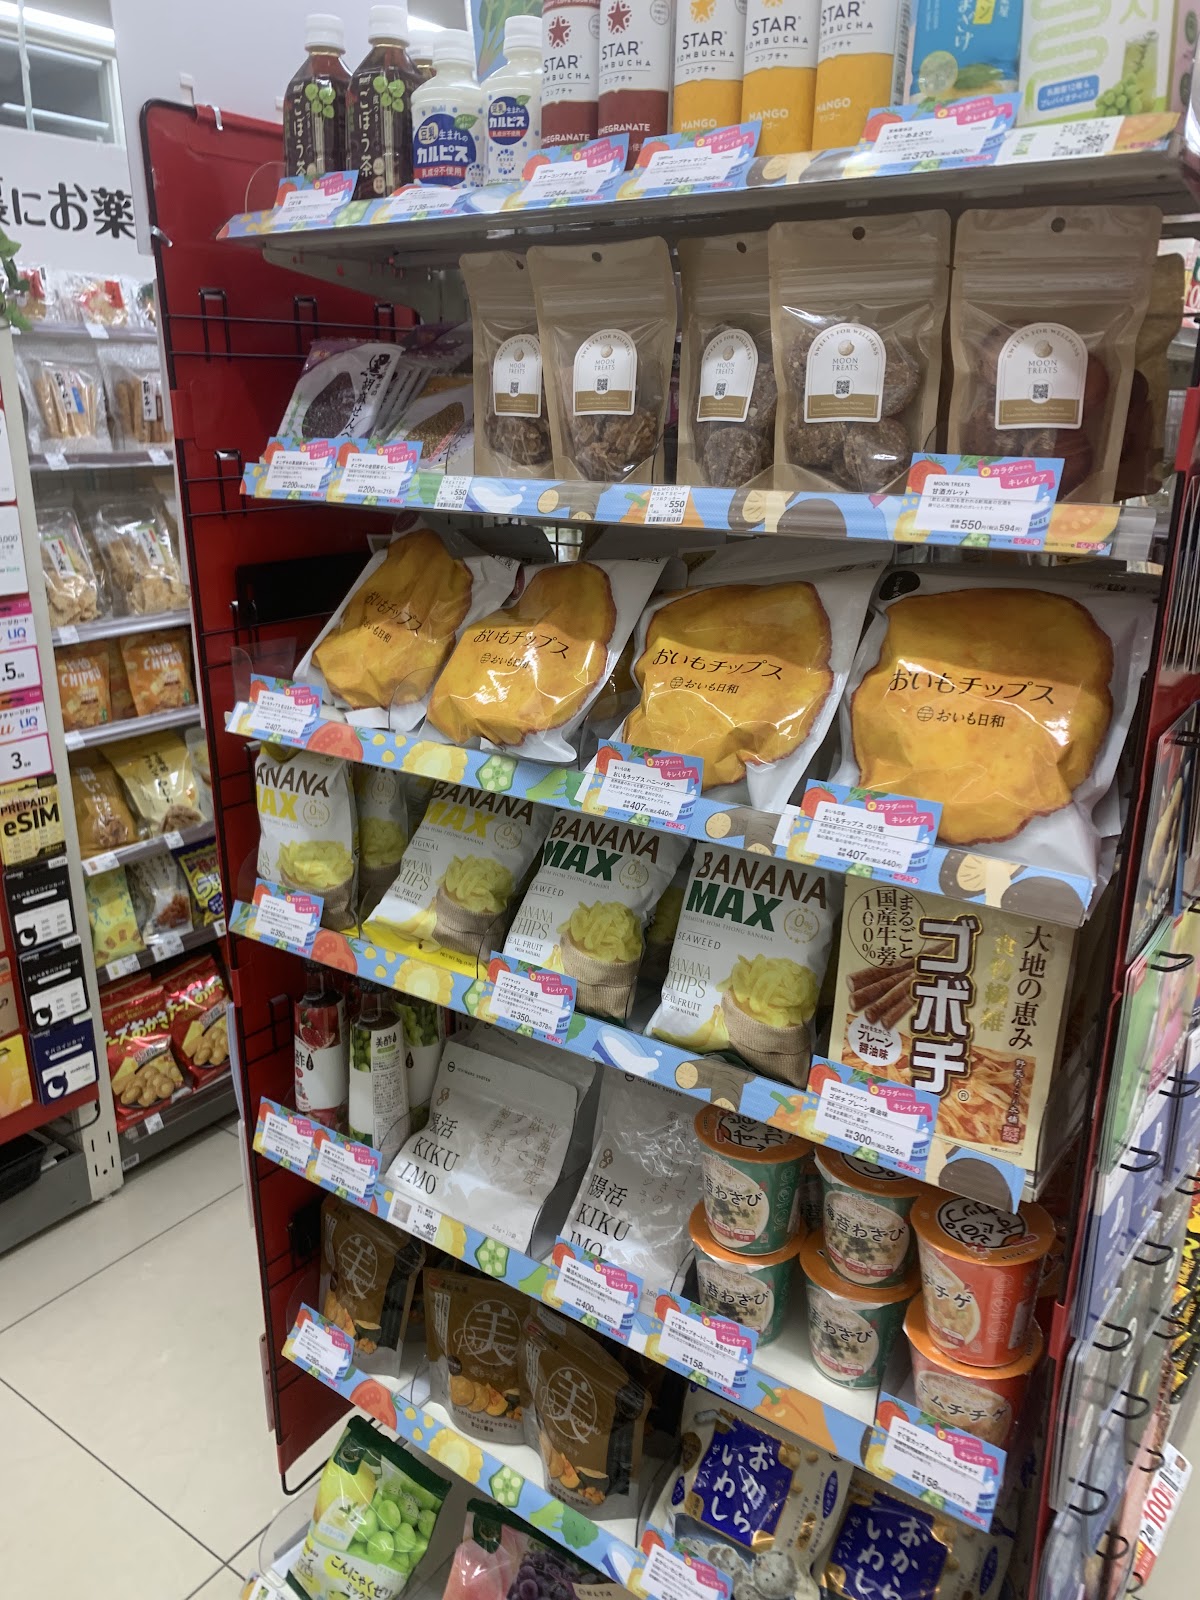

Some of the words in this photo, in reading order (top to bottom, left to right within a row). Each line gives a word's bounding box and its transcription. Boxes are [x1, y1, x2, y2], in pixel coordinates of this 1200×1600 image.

[751, 15, 797, 36] STAR
[602, 41, 639, 60] STAR
[683, 31, 723, 50] STAR
[543, 55, 578, 73] STAR
[489, 116, 526, 128] カルピス
[681, 118, 717, 131] MANGO
[359, 87, 373, 178] ごぼう茶
[417, 145, 468, 164] カルピス
[0, 177, 136, 240] にお薬
[595, 358, 615, 366] MOON
[715, 368, 735, 376] TREATS
[717, 361, 735, 369] MOON
[1026, 366, 1059, 374] TREATS
[1027, 359, 1058, 367] MOON
[1008, 474, 1047, 487] キレイケア
[473, 628, 569, 659] おいもチップス
[652, 648, 783, 681] おいもチップス
[684, 679, 740, 694] おいも日和
[889, 668, 1055, 705] おいもチップス
[936, 709, 1006, 729] おいも日和
[666, 770, 693, 778] キレイケア
[0, 796, 49, 816] PREPAID
[4, 803, 60, 837] eSIM
[823, 815, 864, 828] おいもチップス
[892, 815, 927, 824] キレイケア
[550, 815, 661, 864] BANANA
[543, 840, 622, 882] MAX
[397, 873, 430, 892] HIPS
[695, 851, 827, 910] BANANA
[685, 879, 784, 933] MAX
[706, 920, 720, 929] HOM
[722, 924, 745, 936] THONG
[747, 930, 773, 942] BANANA
[862, 894, 876, 960] 100%
[876, 888, 898, 966] 国産牛蒡
[899, 894, 916, 960] まるごと
[526, 940, 544, 952] FRUIT
[677, 931, 721, 950] SEAWEED
[669, 956, 711, 980] BANANA
[664, 970, 707, 999] CHIPS
[1008, 925, 1053, 1050] 大地の恵み
[678, 997, 702, 1012] FRUIT
[912, 915, 981, 1097] ゴボチ
[857, 1029, 894, 1048] プレーン
[859, 1041, 889, 1061] 醤油味
[848, 1099, 889, 1117] プレーン醤油味
[893, 1104, 926, 1113] キレイケア
[412, 1137, 461, 1172] KIKU
[397, 1161, 437, 1195] IMO
[585, 1173, 628, 1208] 腸活
[575, 1203, 634, 1242] KIKU
[711, 1444, 744, 1521] いわし
